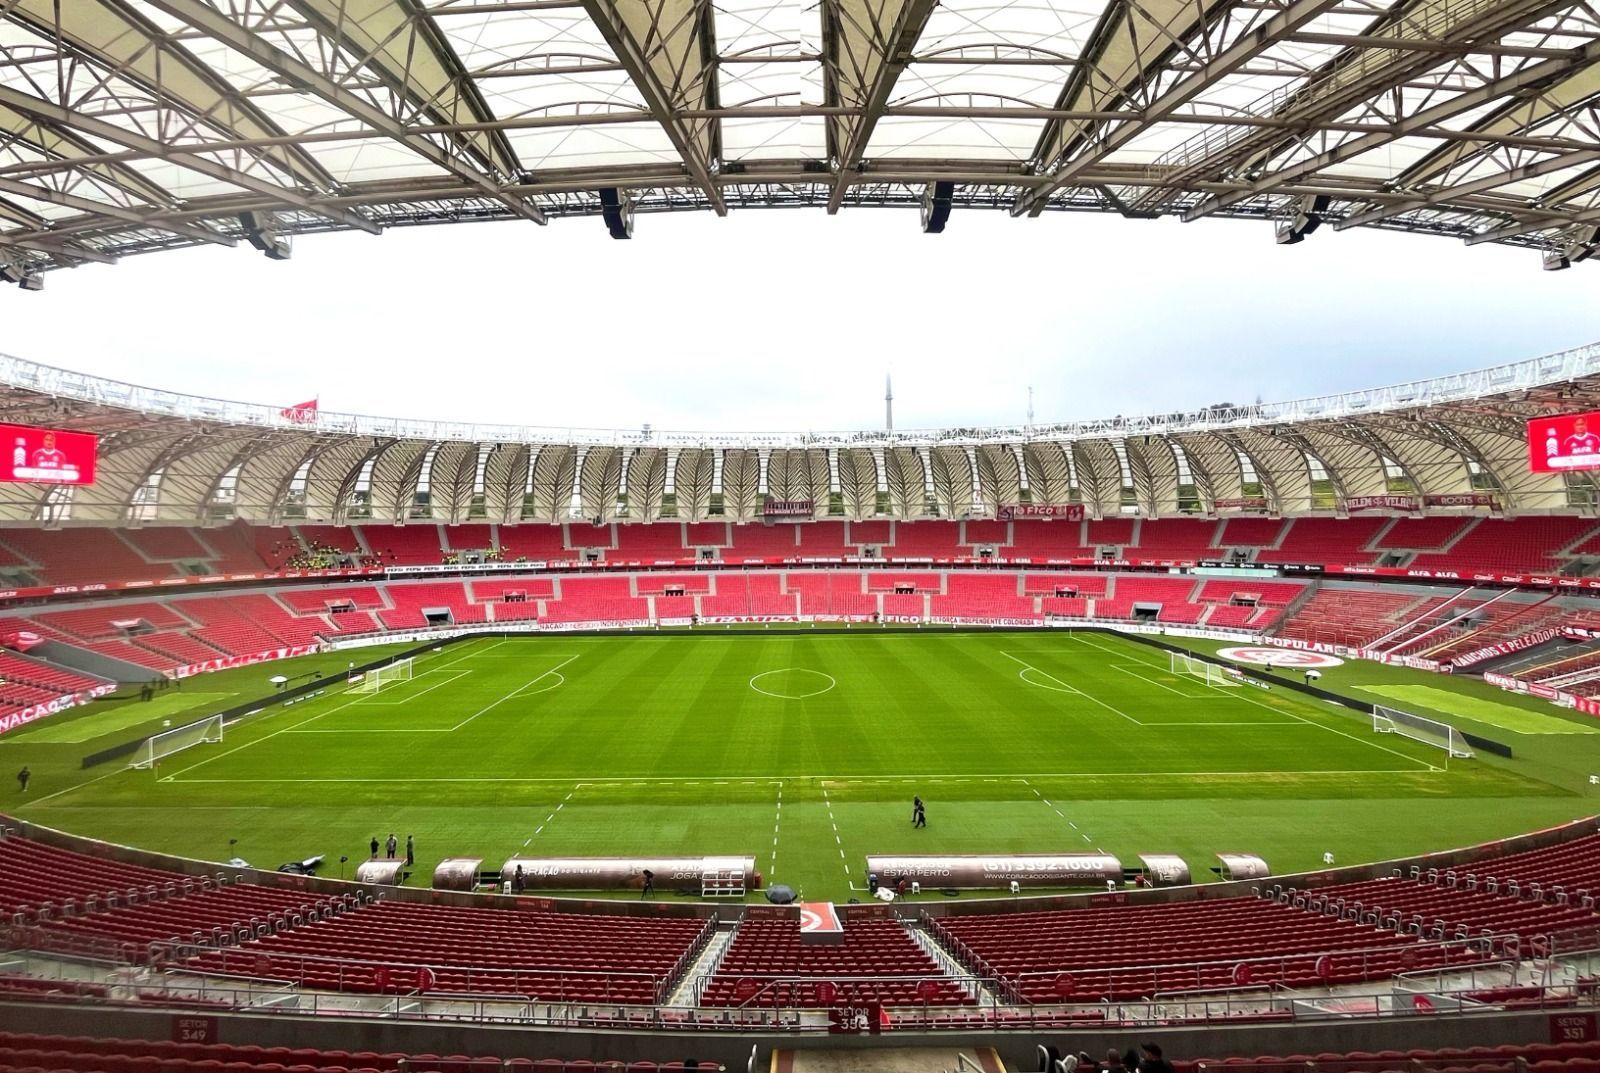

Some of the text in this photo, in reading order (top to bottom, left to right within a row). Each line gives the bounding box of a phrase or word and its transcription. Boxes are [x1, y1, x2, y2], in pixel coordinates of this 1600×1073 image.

[1441, 496, 1473, 504] ROOTS
[1026, 506, 1054, 515] FICO
[1474, 573, 1495, 581] Claro
[1502, 574, 1524, 582] Claro
[1531, 576, 1553, 584] Claro
[1559, 578, 1582, 586] Claro
[887, 615, 920, 624] FICO
[1003, 618, 1035, 626] COLORADA
[1508, 625, 1567, 652] PELEADORES
[1264, 637, 1334, 654] POPULAR
[1361, 649, 1388, 663] 1909
[1015, 859, 1104, 871] 3392.1000
[670, 871, 698, 880] JOGA
[883, 869, 952, 877] ESTAR PERTO.
[838, 1007, 869, 1017] SETOR
[179, 1019, 209, 1029] SETOR
[1556, 1016, 1587, 1027] SETOR
[181, 1029, 207, 1040] 349
[1563, 1027, 1585, 1039] 351
